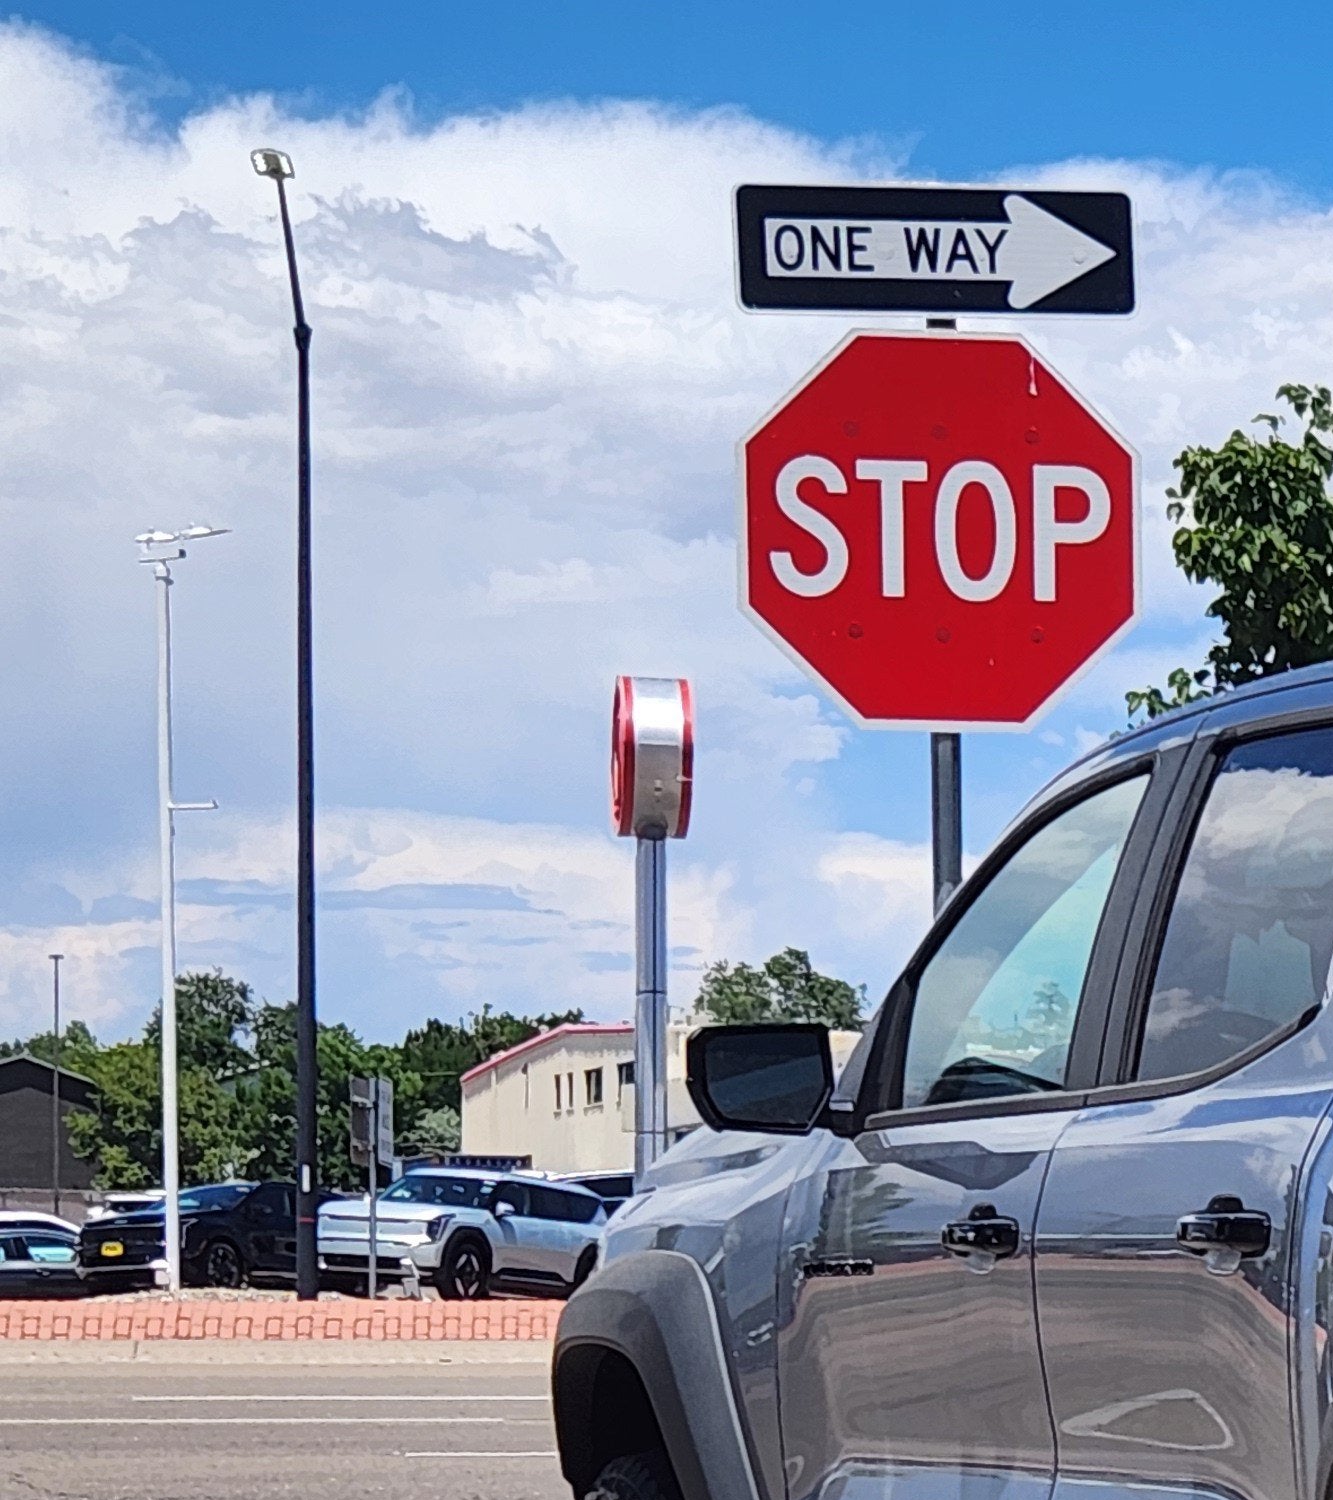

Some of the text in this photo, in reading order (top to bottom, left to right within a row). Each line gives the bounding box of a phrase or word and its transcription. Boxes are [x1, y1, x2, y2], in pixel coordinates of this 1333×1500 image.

[774, 224, 1008, 275] ONE WAY
[769, 453, 1113, 603] STOP
